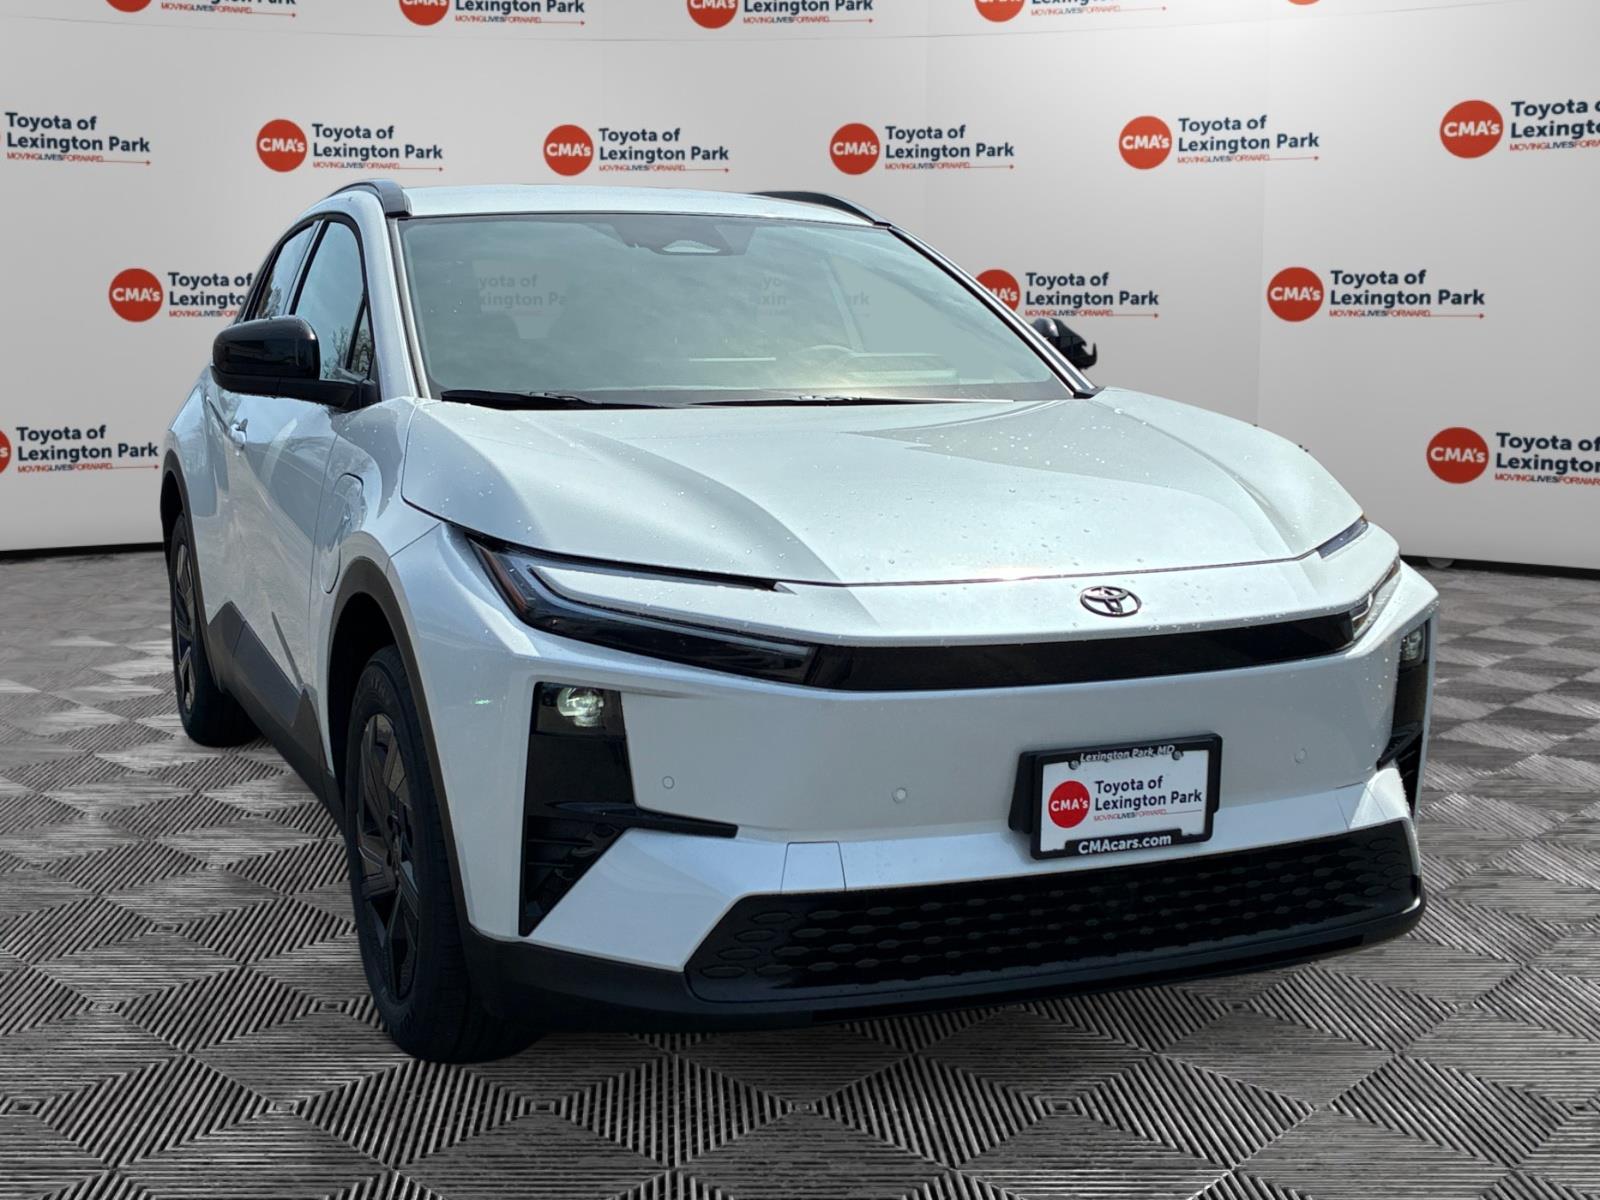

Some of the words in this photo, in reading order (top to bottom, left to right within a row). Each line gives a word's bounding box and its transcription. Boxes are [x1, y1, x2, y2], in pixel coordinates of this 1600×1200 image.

[455, 0, 541, 14] Lexington
[547, 0, 585, 13] Park
[744, 0, 829, 15] Lexington
[835, 0, 873, 11] Park
[1511, 99, 1588, 120] Toyota
[5, 112, 72, 132] Toyota
[77, 116, 97, 130] of
[1178, 117, 1241, 135] Toyota
[1247, 115, 1267, 129] of
[1443, 120, 1500, 137] CMA's
[1511, 119, 1600, 139] Lexingt
[312, 124, 371, 141] Toyota
[376, 125, 394, 139] of
[599, 128, 657, 145] Toyota
[662, 128, 680, 142] of
[885, 126, 943, 143] Toyota
[947, 125, 966, 139] of
[7, 132, 103, 153] Lexington
[109, 136, 150, 152] Park
[259, 138, 305, 153] CMA's
[546, 143, 591, 157] CMA's
[832, 141, 878, 156] CMA's
[1122, 134, 1170, 150] CMA's
[1178, 137, 1270, 154] Lexington
[1277, 132, 1319, 148] Park
[313, 143, 399, 161] Lexington
[404, 144, 442, 159] Park
[600, 146, 685, 163] Lexington
[691, 146, 729, 160] Park
[885, 145, 970, 161] Lexington
[976, 143, 1014, 157] Park
[168, 272, 229, 290] Toyota
[234, 273, 252, 288] of
[479, 274, 515, 290] yota
[1026, 272, 1085, 290] Toyota
[1090, 272, 1109, 286] of
[1330, 270, 1398, 288] Toyota
[1404, 269, 1426, 284] of
[112, 287, 160, 302] CMA's
[169, 291, 246, 309] Lexingto
[480, 291, 544, 309] xington
[1026, 291, 1113, 308] Lexington
[1119, 291, 1159, 305] Park
[1270, 287, 1321, 301] CMA's
[1330, 290, 1432, 308] Lexington
[1438, 289, 1485, 305] Park
[17, 426, 81, 444] Toyota
[87, 425, 106, 439] of
[1496, 432, 1572, 453] Toyota
[1578, 436, 1600, 451] of
[18, 446, 112, 463] Lexington
[118, 442, 158, 458] Park
[1431, 447, 1485, 462] CMA's
[1080, 751, 1130, 763] Lexington
[1157, 745, 1175, 757] MD
[1094, 779, 1143, 796] Toyota
[1148, 775, 1163, 790] of
[1051, 798, 1088, 812] CMA's
[1095, 793, 1166, 812] Lexington
[1170, 789, 1202, 804] Park
[1078, 834, 1172, 854] CMAcars.com
